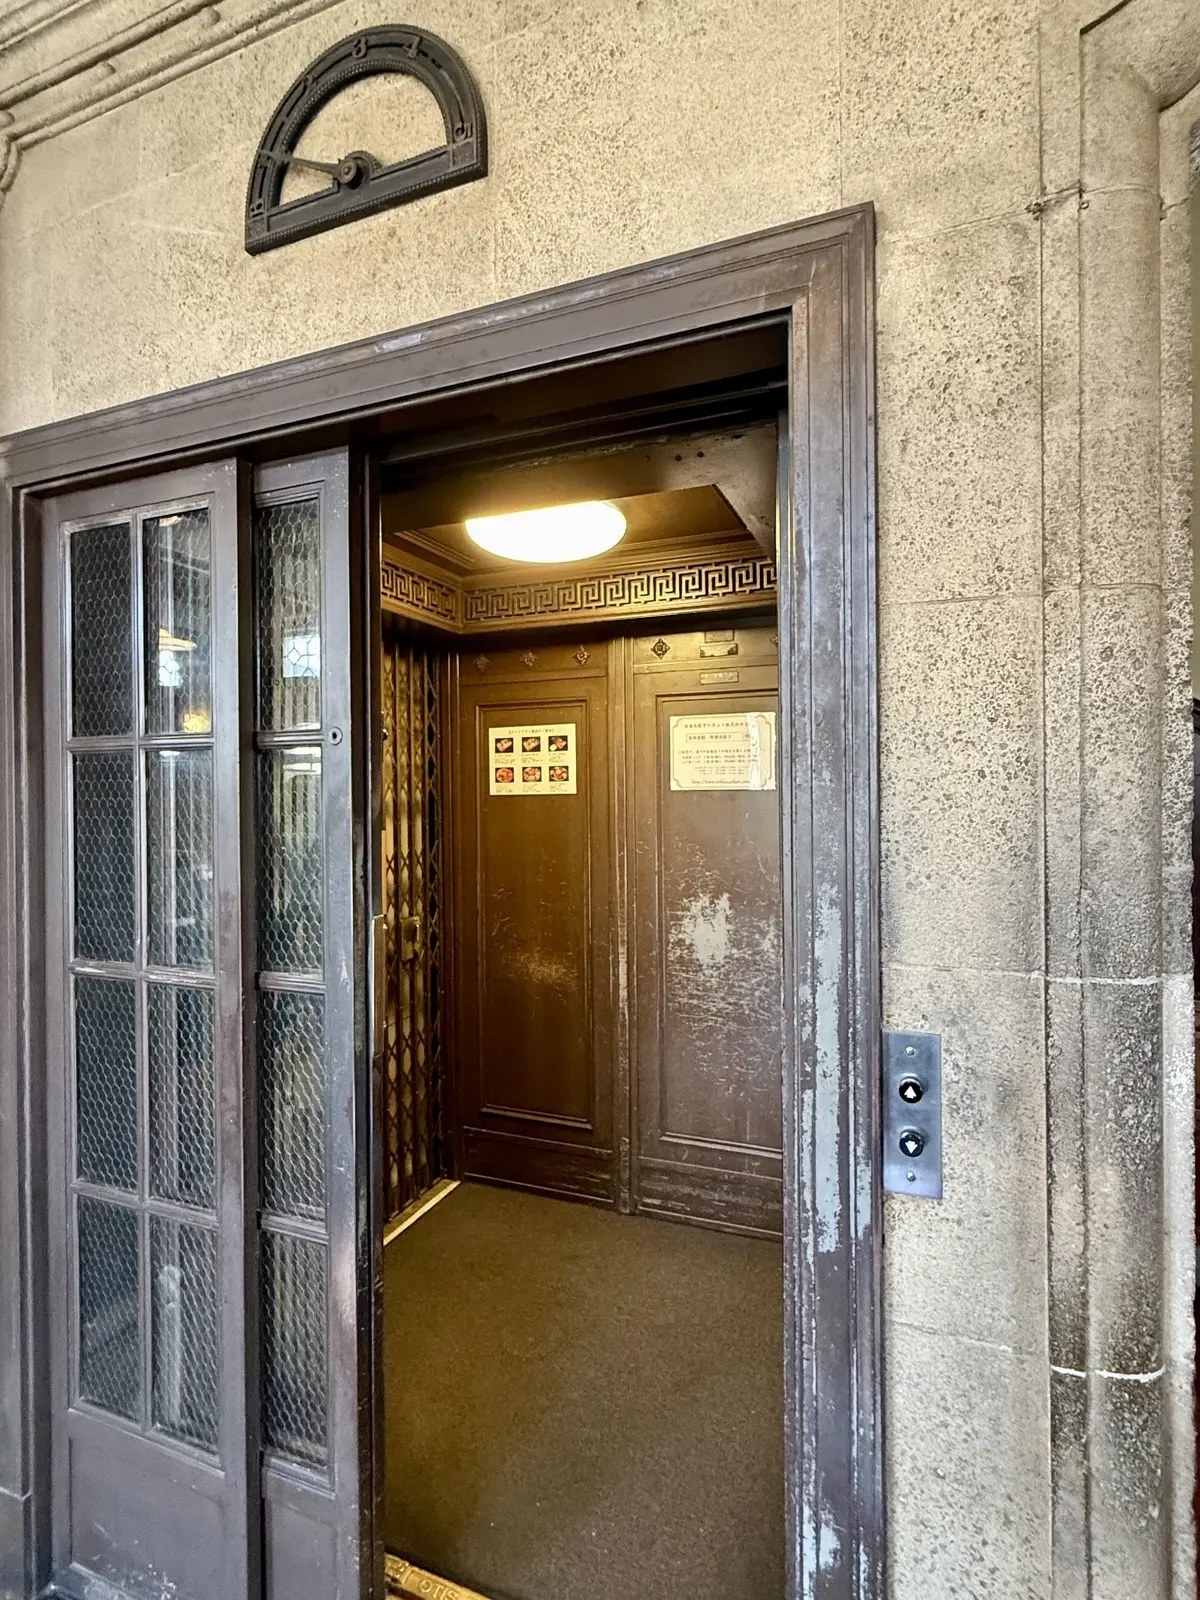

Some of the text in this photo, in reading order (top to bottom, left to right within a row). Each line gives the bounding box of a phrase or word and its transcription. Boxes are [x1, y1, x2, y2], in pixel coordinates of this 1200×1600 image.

[352, 35, 368, 59] 3
[454, 122, 473, 141] 5
[420, 1579, 460, 1600] OTIS
